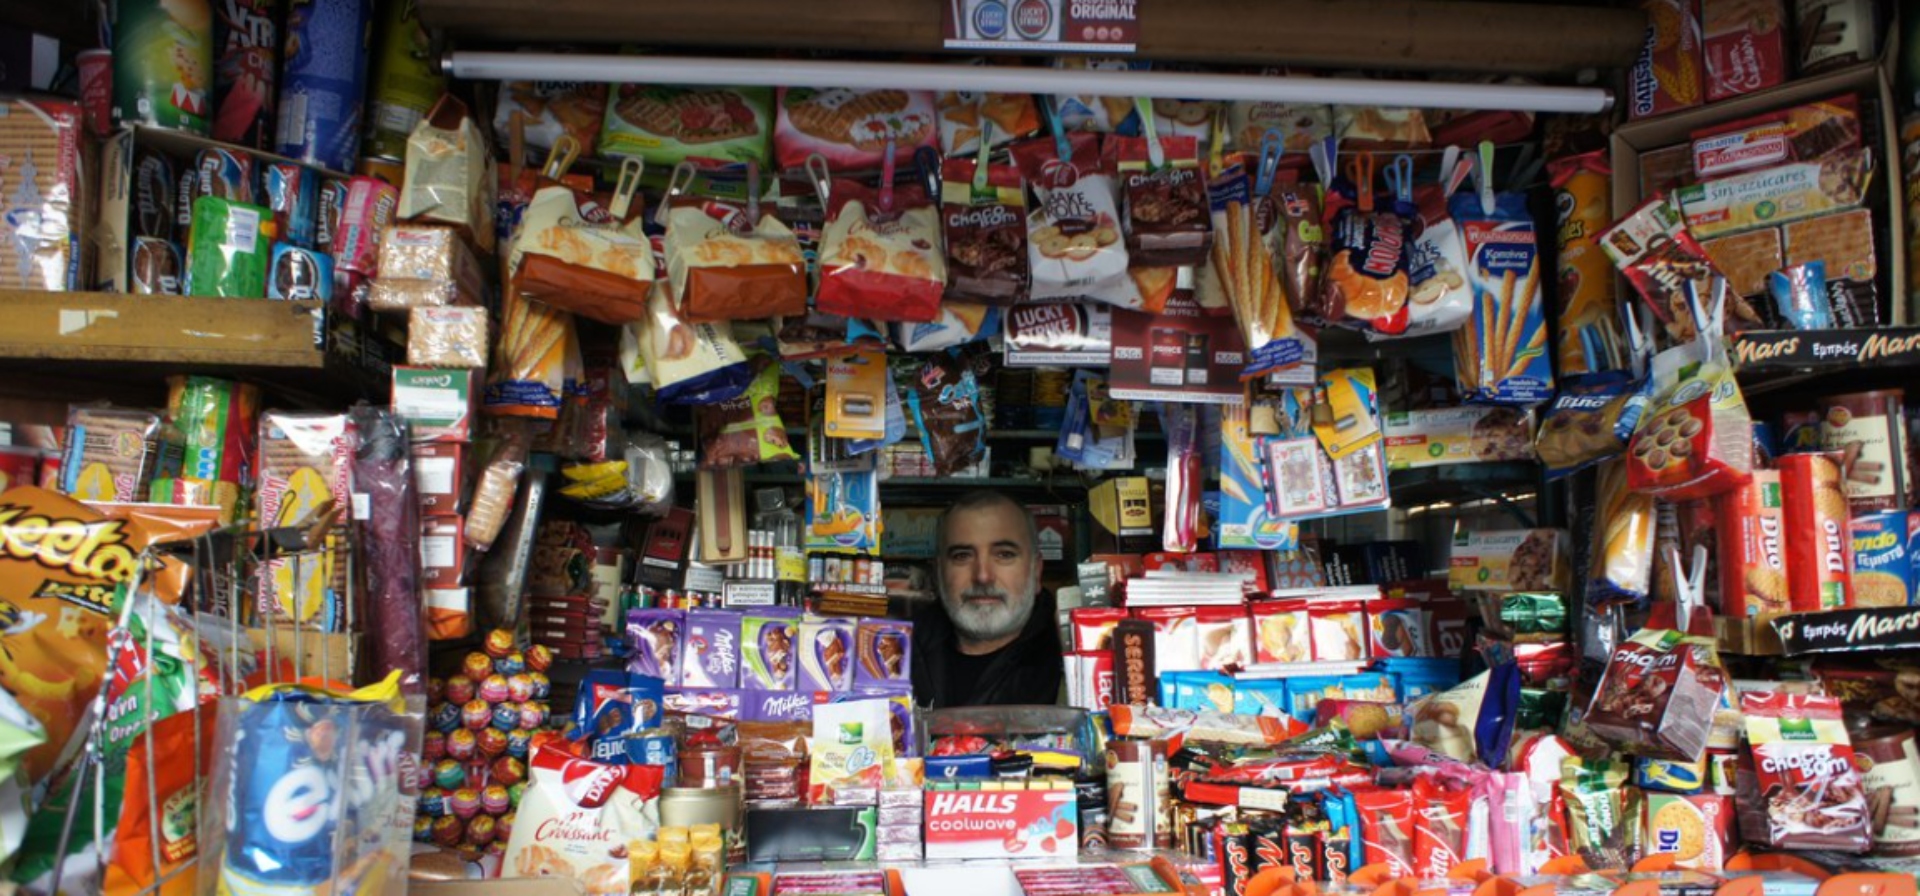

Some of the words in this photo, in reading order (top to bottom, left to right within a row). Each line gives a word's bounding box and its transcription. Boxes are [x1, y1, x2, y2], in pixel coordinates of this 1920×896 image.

[1019, 17, 1045, 27] STRIKE
[1020, 8, 1044, 17] LUCKY
[1070, 4, 1136, 20] ORIGINAL
[1014, 305, 1066, 328] LUCKY
[1016, 317, 1072, 342] STRIKE
[1813, 340, 1858, 359] Εμπρός
[828, 365, 857, 376] Kodak
[1760, 515, 1781, 570] Duo
[1824, 519, 1844, 573] Duo
[1803, 620, 1847, 642] Εμπρός
[1846, 609, 1920, 643] Mars
[762, 692, 811, 718] Milka
[586, 765, 622, 801] DAYS
[930, 793, 1018, 816] HALLS
[534, 815, 613, 842] Croissant
[929, 817, 1017, 831] coolwave
